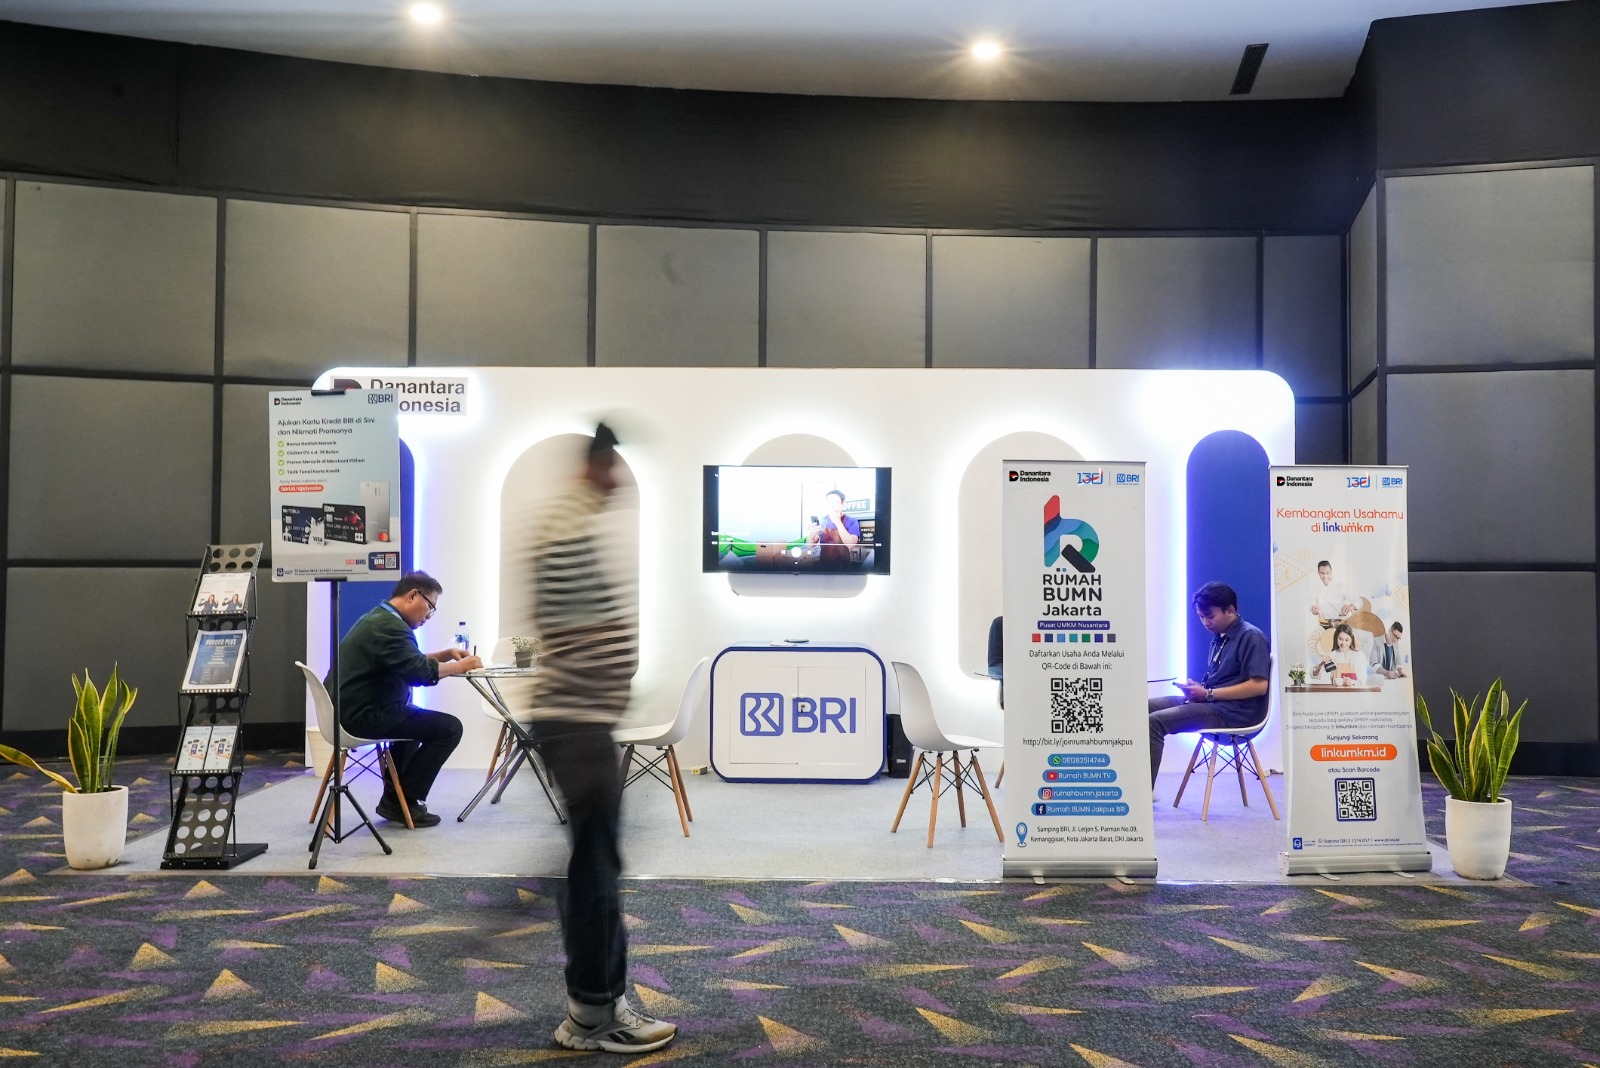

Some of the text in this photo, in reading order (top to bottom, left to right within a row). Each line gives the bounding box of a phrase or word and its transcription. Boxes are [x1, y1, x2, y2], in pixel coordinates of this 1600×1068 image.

[370, 378, 464, 394] Danantara
[378, 394, 393, 402] BRI
[400, 398, 460, 412] onesia
[842, 502, 866, 510] OFFEE
[1277, 508, 1404, 520] Kembangkan Usahamu
[1311, 522, 1321, 532] di
[1043, 587, 1102, 602] BUMN
[1043, 604, 1102, 616] Jakarta
[1029, 649, 1061, 658] Daftarkan
[1101, 649, 1124, 658] Melalui
[1042, 662, 1070, 671] QR-Code
[792, 697, 856, 734] BRI
[1023, 738, 1133, 747] http://bit.ly/joinrumahbumnjakpus
[1321, 747, 1386, 757] linkumkm.id
